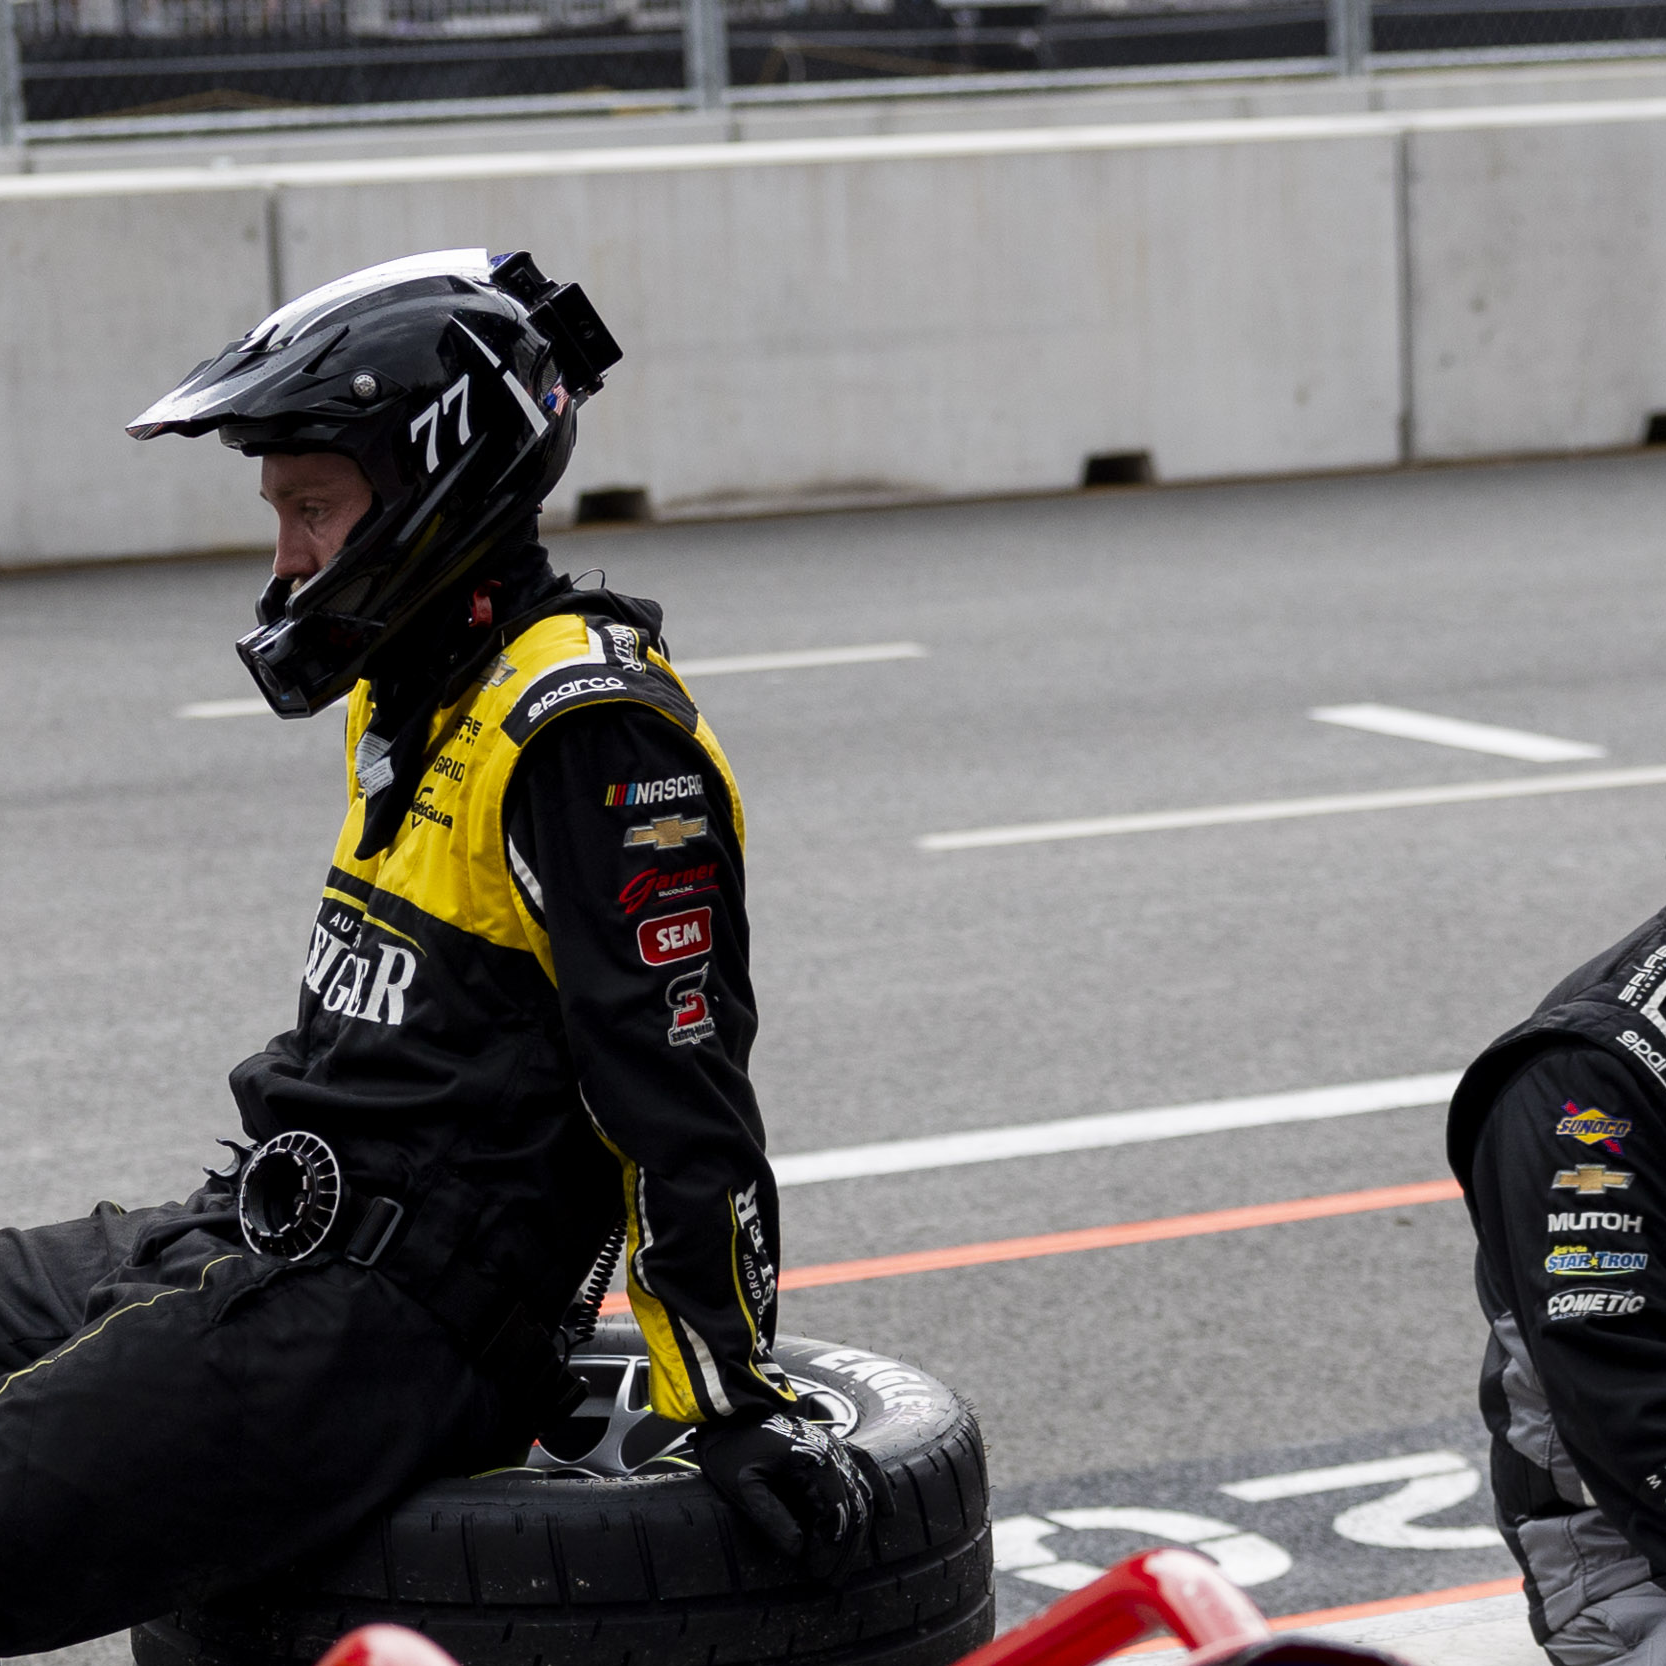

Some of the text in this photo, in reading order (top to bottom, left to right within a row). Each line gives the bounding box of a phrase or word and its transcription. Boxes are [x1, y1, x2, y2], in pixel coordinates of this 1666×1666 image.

[410, 374, 472, 473] 77
[527, 677, 627, 723] sparco
[635, 774, 704, 805] NASCAR
[619, 863, 718, 914] Garner
[657, 921, 702, 952] SEM
[1558, 1119, 1630, 1136] SUNOCO
[1548, 1213, 1643, 1233] MUTOH
[743, 1254, 761, 1299] GROUP
[1548, 1294, 1646, 1316] COMETIC
[808, 1350, 934, 1411] EAGLE
